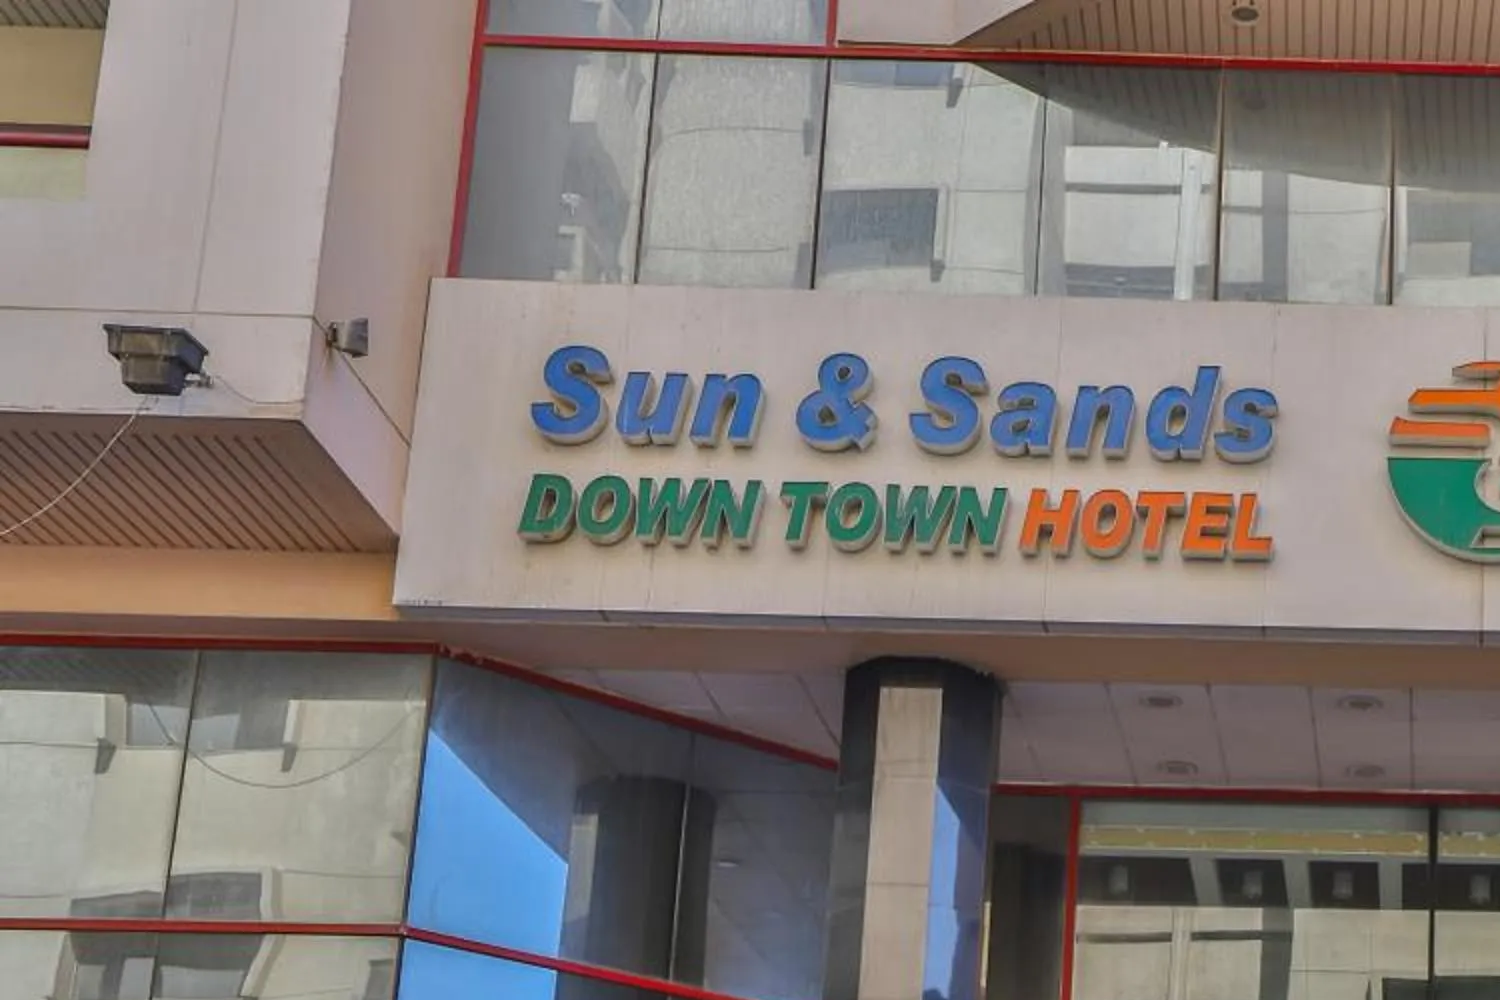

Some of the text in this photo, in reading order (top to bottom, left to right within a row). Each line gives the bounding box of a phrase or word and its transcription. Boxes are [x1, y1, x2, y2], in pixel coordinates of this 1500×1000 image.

[530, 345, 1279, 463] Sun & Sands
[517, 473, 1276, 561] DOWN TOWN HOTEL
